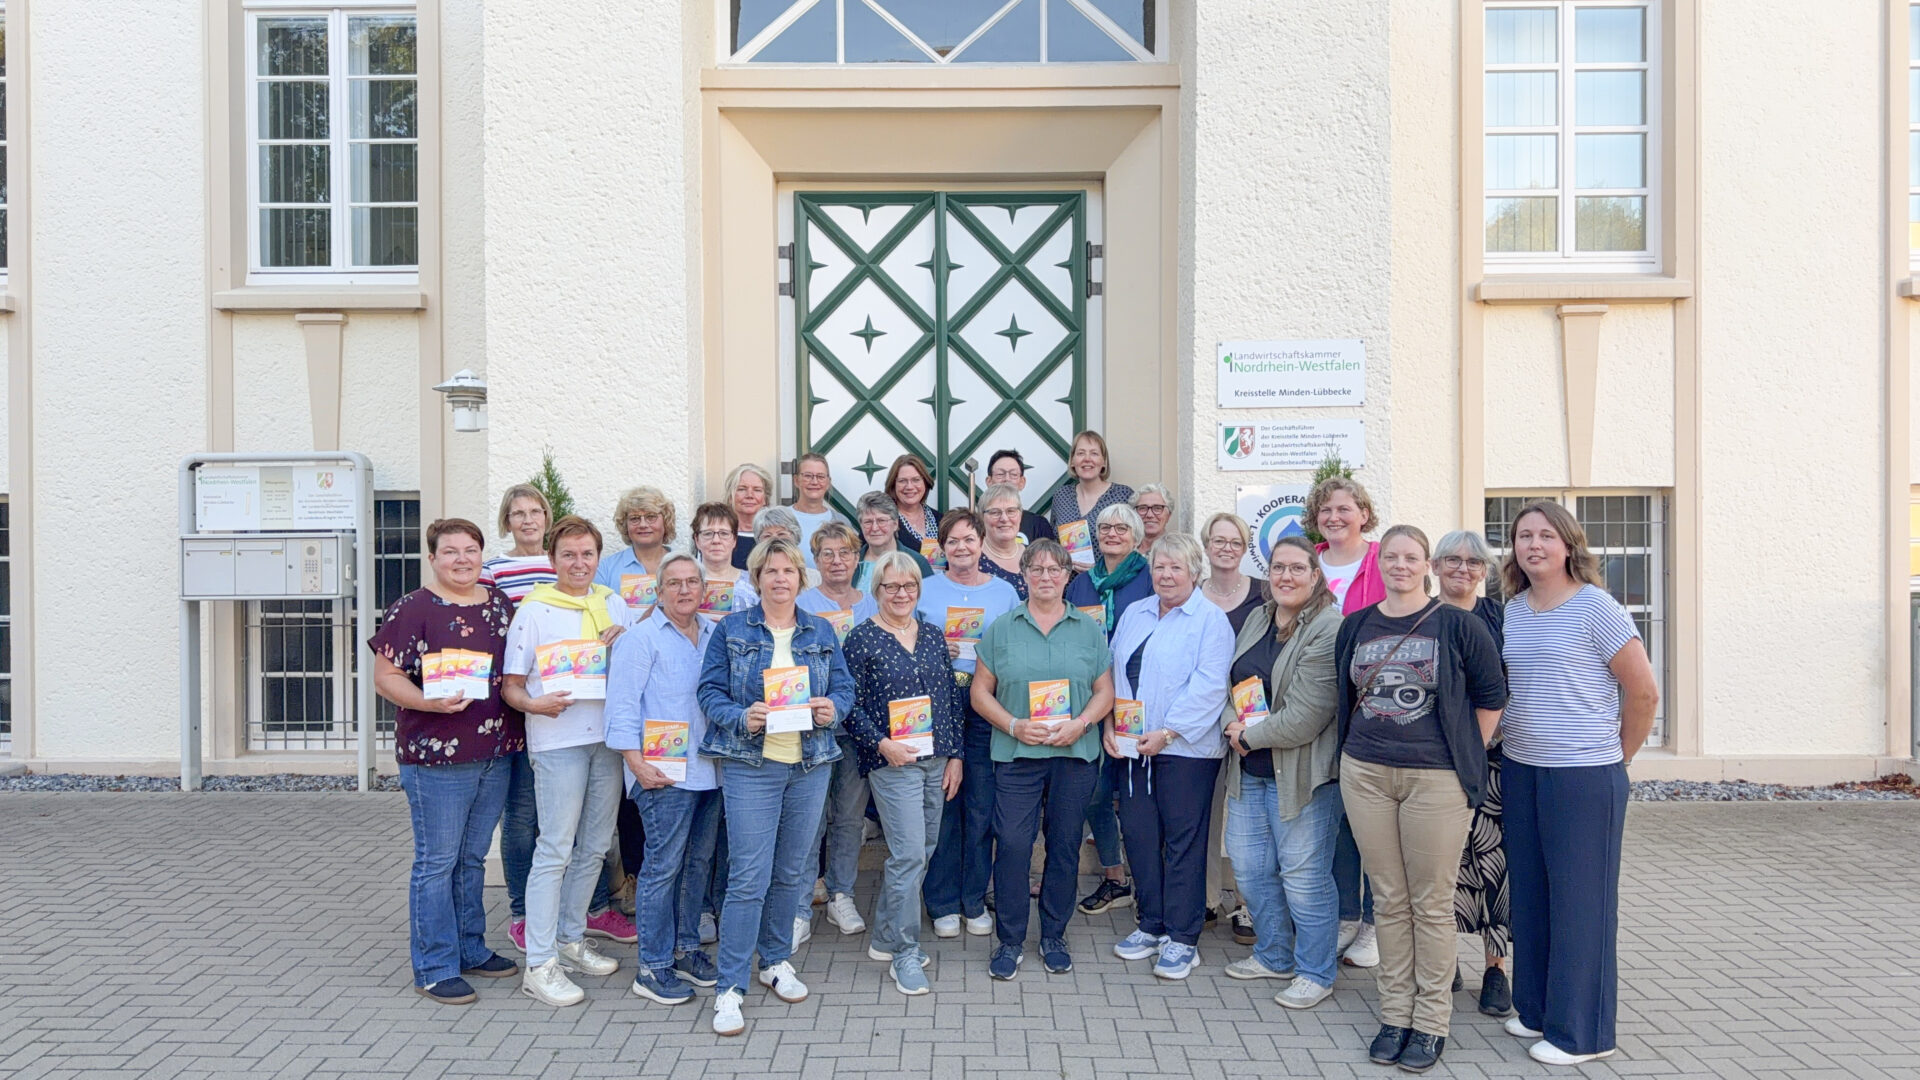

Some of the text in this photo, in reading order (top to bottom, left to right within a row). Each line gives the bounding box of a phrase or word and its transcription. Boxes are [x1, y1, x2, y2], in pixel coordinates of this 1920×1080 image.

[1234, 351, 1341, 360] Landwirtschaftskammer
[1234, 360, 1360, 373] Nordrhein-Westfalen
[1234, 388, 1352, 397] Kreisstelle Minden-Lübbecke
[1257, 495, 1306, 518] KOOPERA
